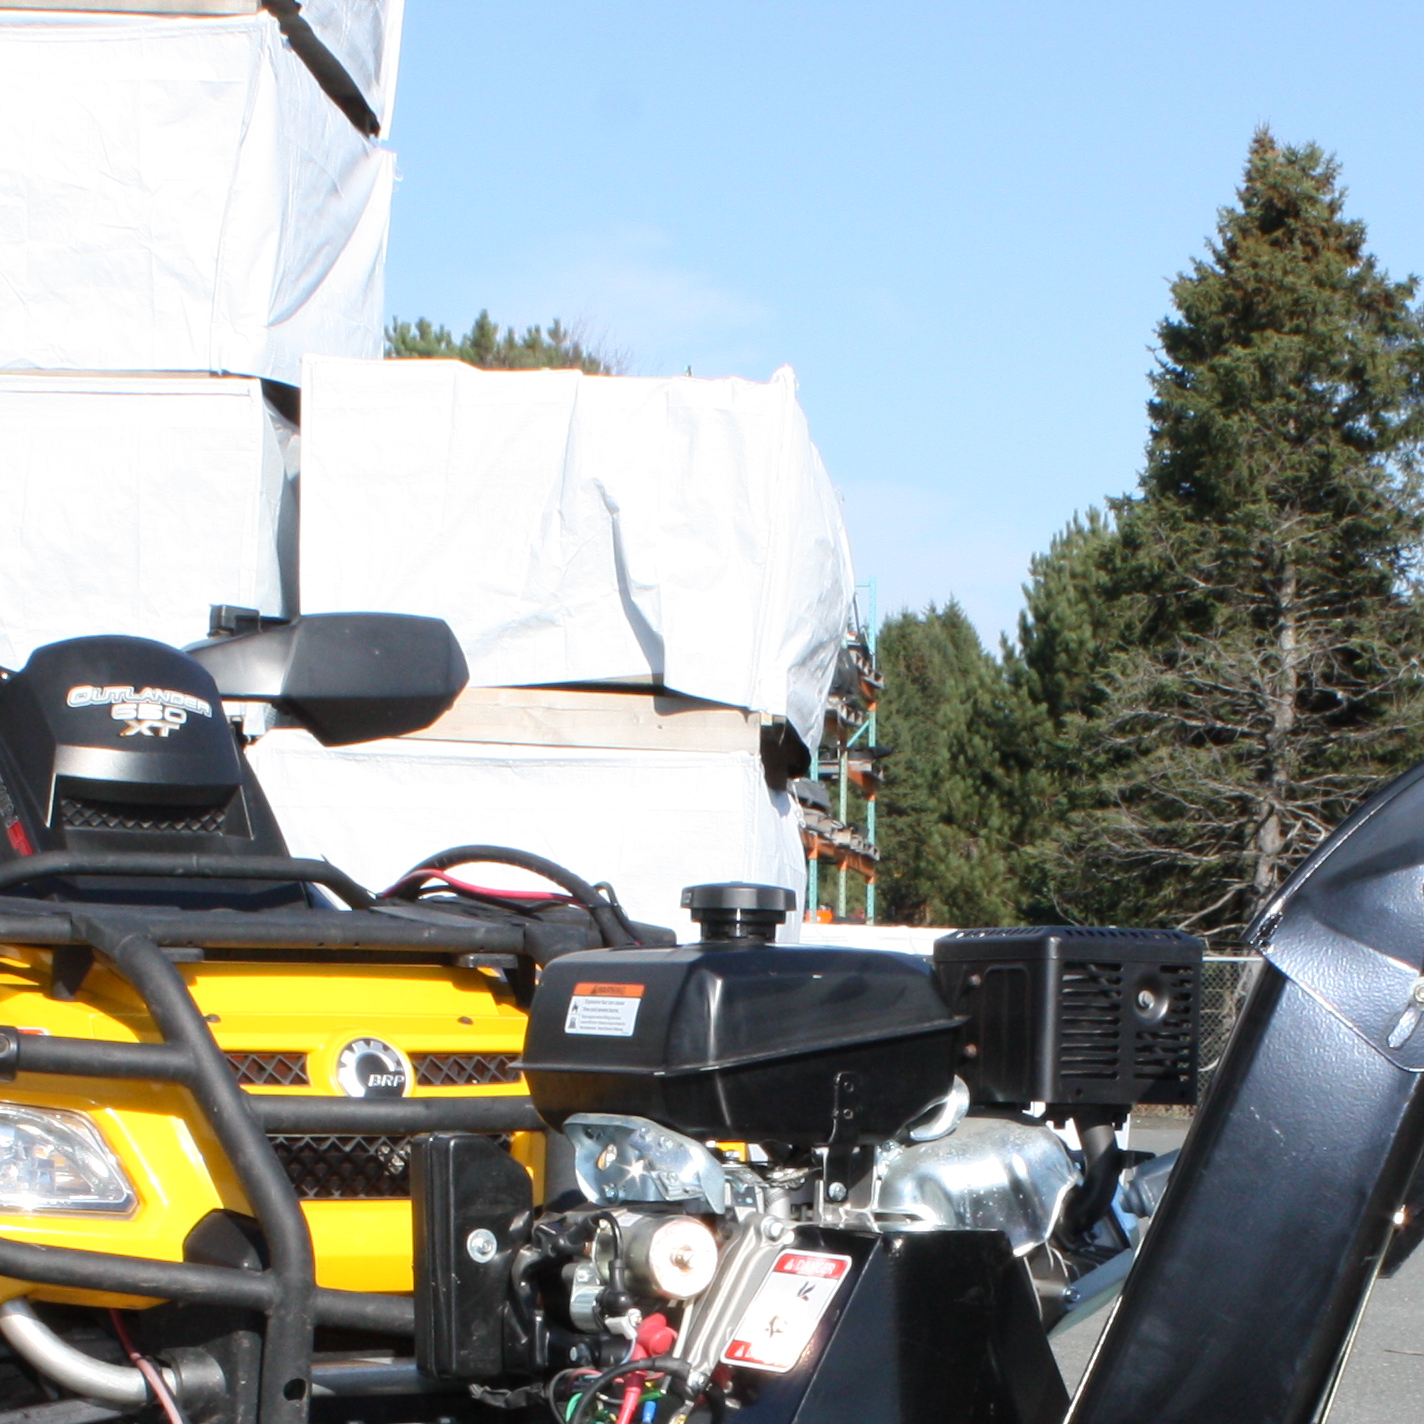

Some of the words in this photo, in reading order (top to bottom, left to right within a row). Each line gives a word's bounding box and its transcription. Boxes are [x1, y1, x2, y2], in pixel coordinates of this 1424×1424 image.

[66, 684, 213, 718] OUTLANDER
[111, 703, 188, 725] 650
[120, 719, 181, 738] XT
[367, 1073, 405, 1088] BRP
[795, 1259, 837, 1276] DANGER
